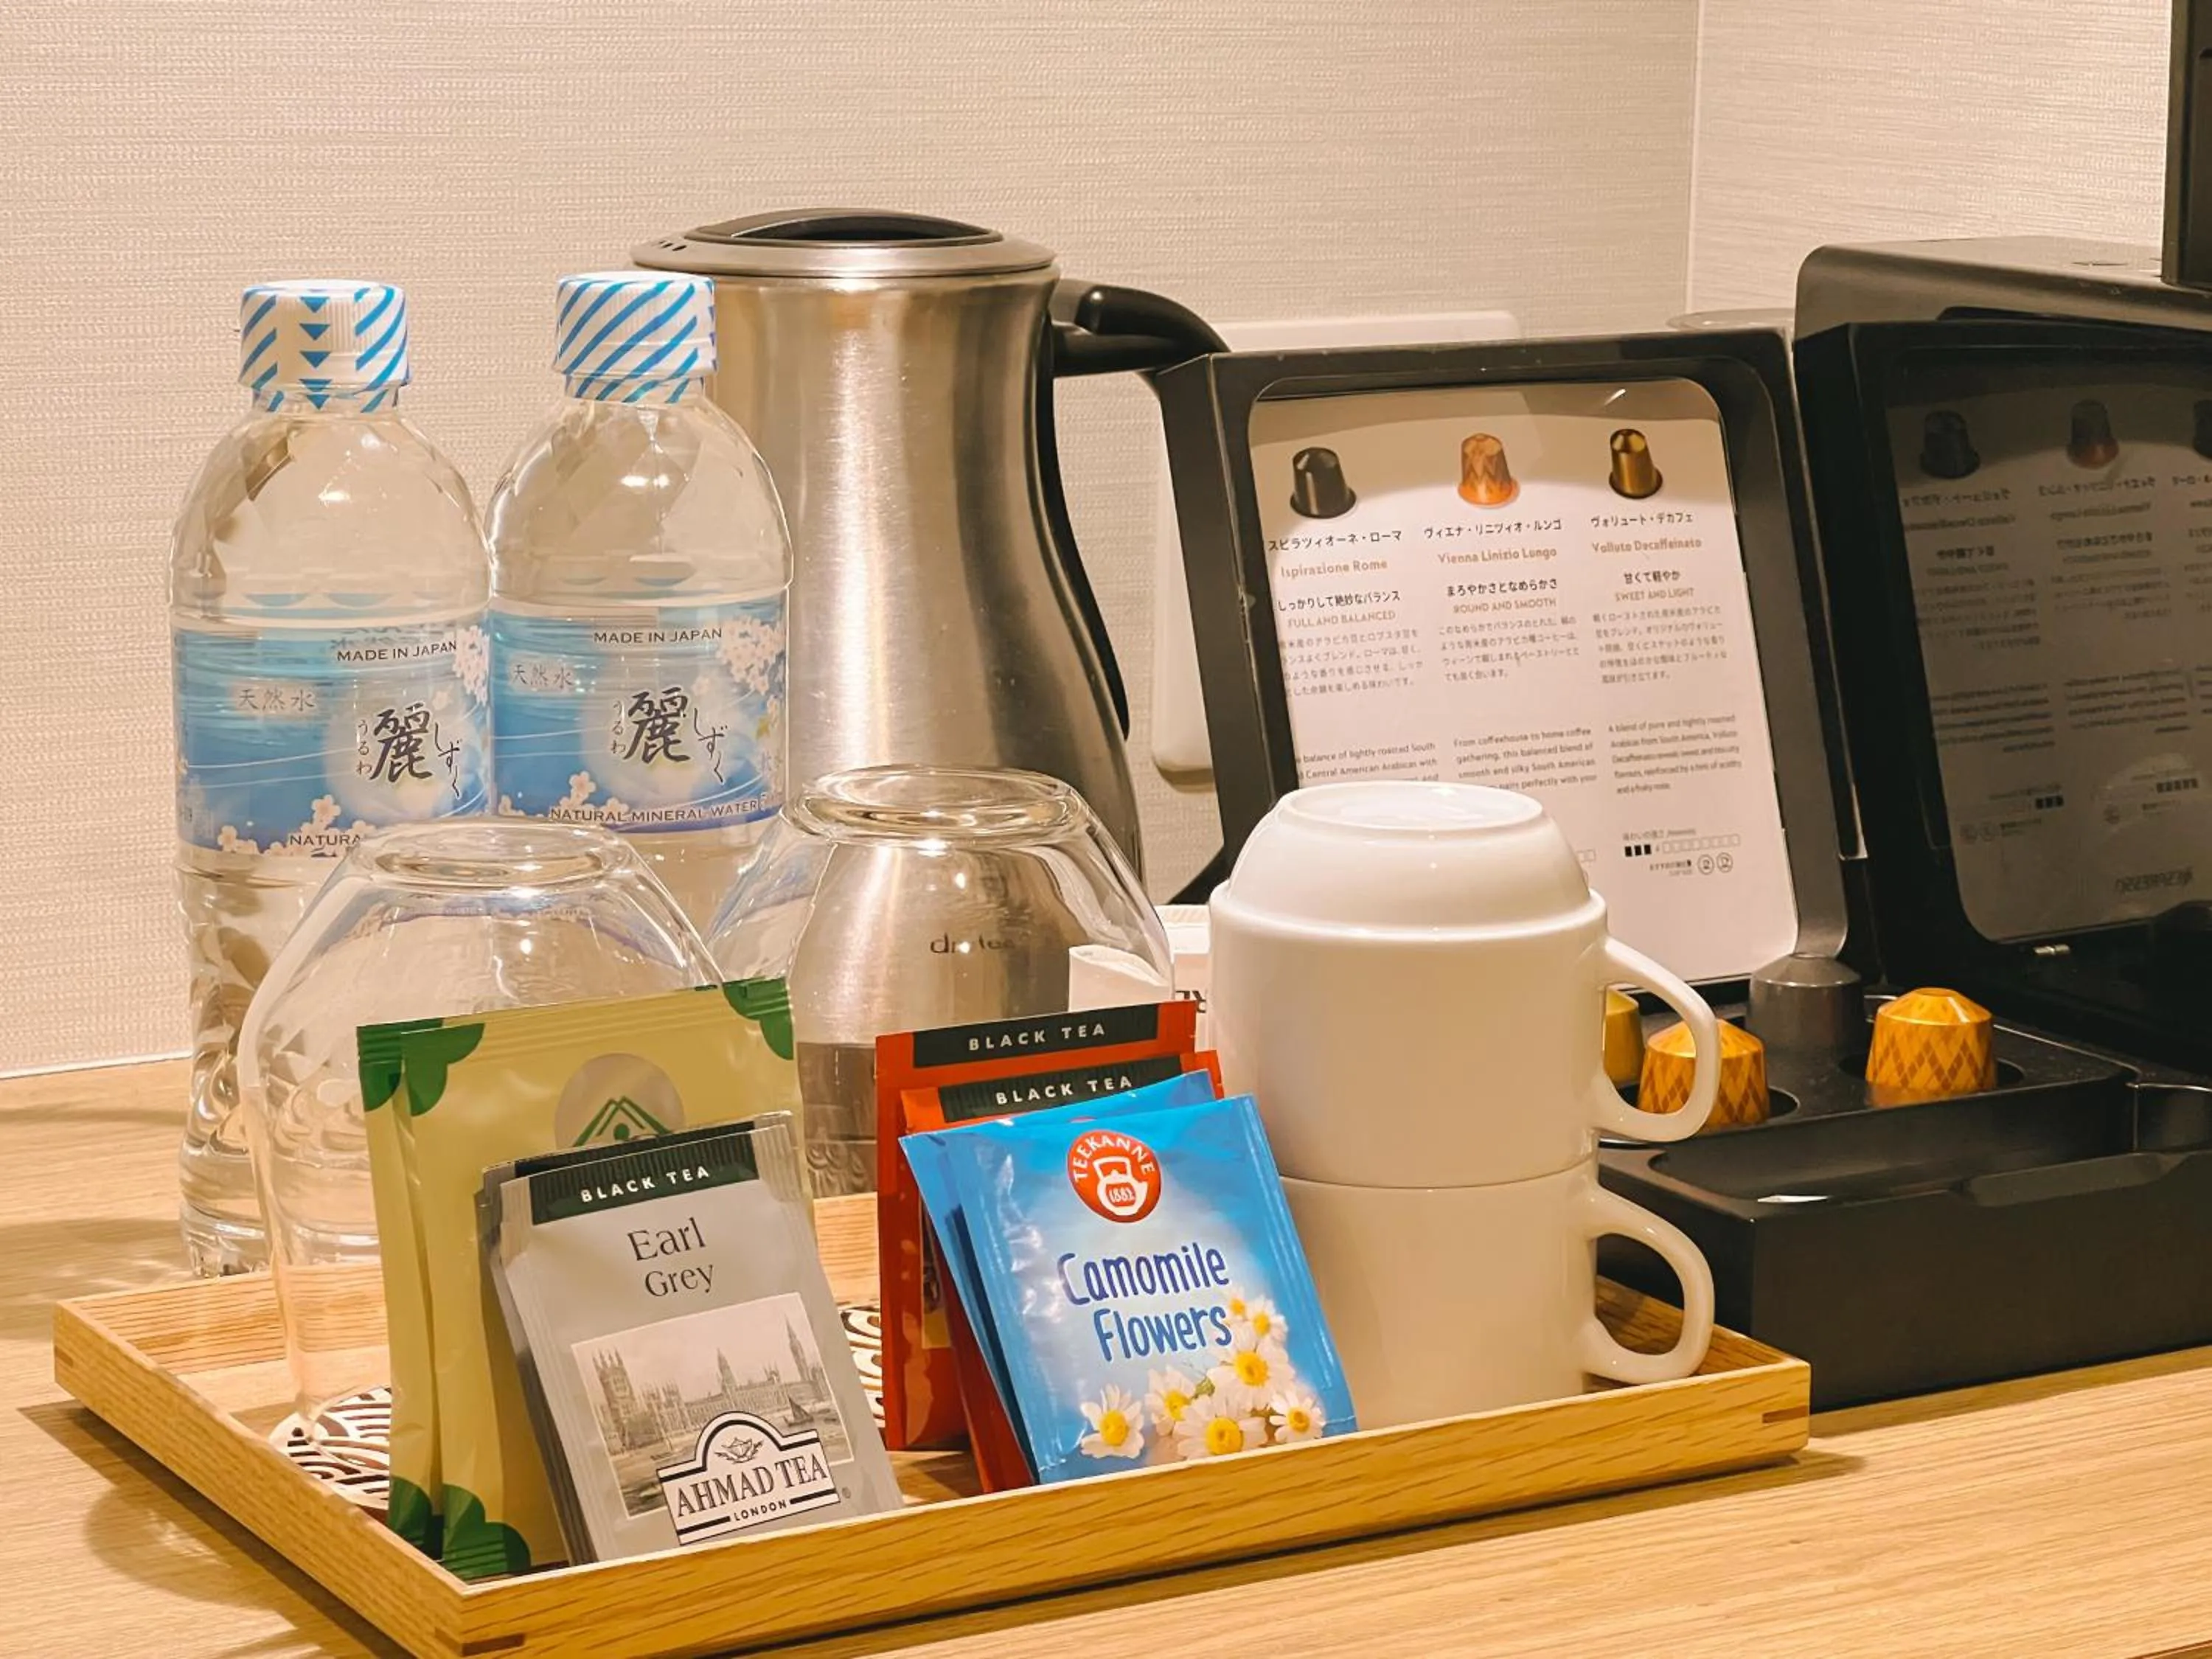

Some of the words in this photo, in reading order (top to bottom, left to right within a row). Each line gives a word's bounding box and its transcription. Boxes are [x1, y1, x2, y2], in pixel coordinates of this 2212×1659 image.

[1438, 552, 1479, 564] Vienna
[1481, 549, 1520, 562] Linizio
[1522, 547, 1557, 562] Lungo
[1281, 562, 1350, 580] Ispirazione
[1447, 578, 1557, 597] まろやかさとなめらかさ
[1615, 591, 1646, 602] SWEET
[1648, 589, 1666, 599] AND
[1668, 587, 1694, 599] LIGHT
[1278, 590, 1401, 612] しっかりして絶妙なバランス
[1453, 602, 1489, 613] ROUND
[1492, 599, 1512, 611] AND
[1514, 597, 1557, 610] SMOOTH
[1287, 616, 1315, 628] FULL
[1316, 615, 1339, 627] AND
[1340, 610, 1397, 625] BALANCED
[593, 631, 643, 644] MADE
[648, 630, 664, 643] IN
[669, 627, 723, 643] JAPAN
[337, 649, 388, 662] MADE
[392, 647, 409, 660] IN
[412, 639, 457, 658] JAPAN
[513, 664, 574, 689] 天然水
[238, 687, 317, 713] 天然水
[1453, 738, 1476, 748] From
[1478, 733, 1529, 746] coffeehouse
[1541, 729, 1564, 740] home
[1565, 727, 1592, 737] coffee
[1303, 754, 1336, 764] balance
[1338, 750, 1348, 759] of
[1349, 748, 1376, 759] lightly
[1377, 744, 1409, 755] roasted
[1411, 742, 1436, 752] South
[1305, 768, 1337, 779] Central
[1340, 764, 1380, 776] American
[1382, 759, 1417, 771] Arabicas
[1419, 757, 1438, 768] with
[1493, 765, 1509, 775] and
[1511, 762, 1530, 774] silky
[1531, 761, 1557, 771] South
[1521, 776, 1558, 790] perfectly
[1560, 774, 1579, 784] with
[550, 807, 629, 822] NATURAL
[632, 808, 706, 822] MINERAL
[711, 799, 757, 817] WATER
[289, 834, 362, 846] NATURA
[968, 1030, 1047, 1051] BLACK
[1062, 1023, 1106, 1040] TEA
[995, 1082, 1074, 1106] BLACK
[1087, 1076, 1133, 1093] TEA
[1073, 1135, 1156, 1183] TEEKANNE
[580, 1175, 655, 1203] BLACK
[666, 1165, 712, 1187] TEA
[1109, 1186, 1135, 1203] 1882
[627, 1217, 707, 1262] Earl
[644, 1264, 715, 1298] Grey
[1057, 1242, 1231, 1307] Camomile
[1092, 1304, 1233, 1363] Flowers
[676, 1464, 776, 1518] AHMAD
[774, 1453, 830, 1489] TEA
[734, 1499, 787, 1522] LONDON
